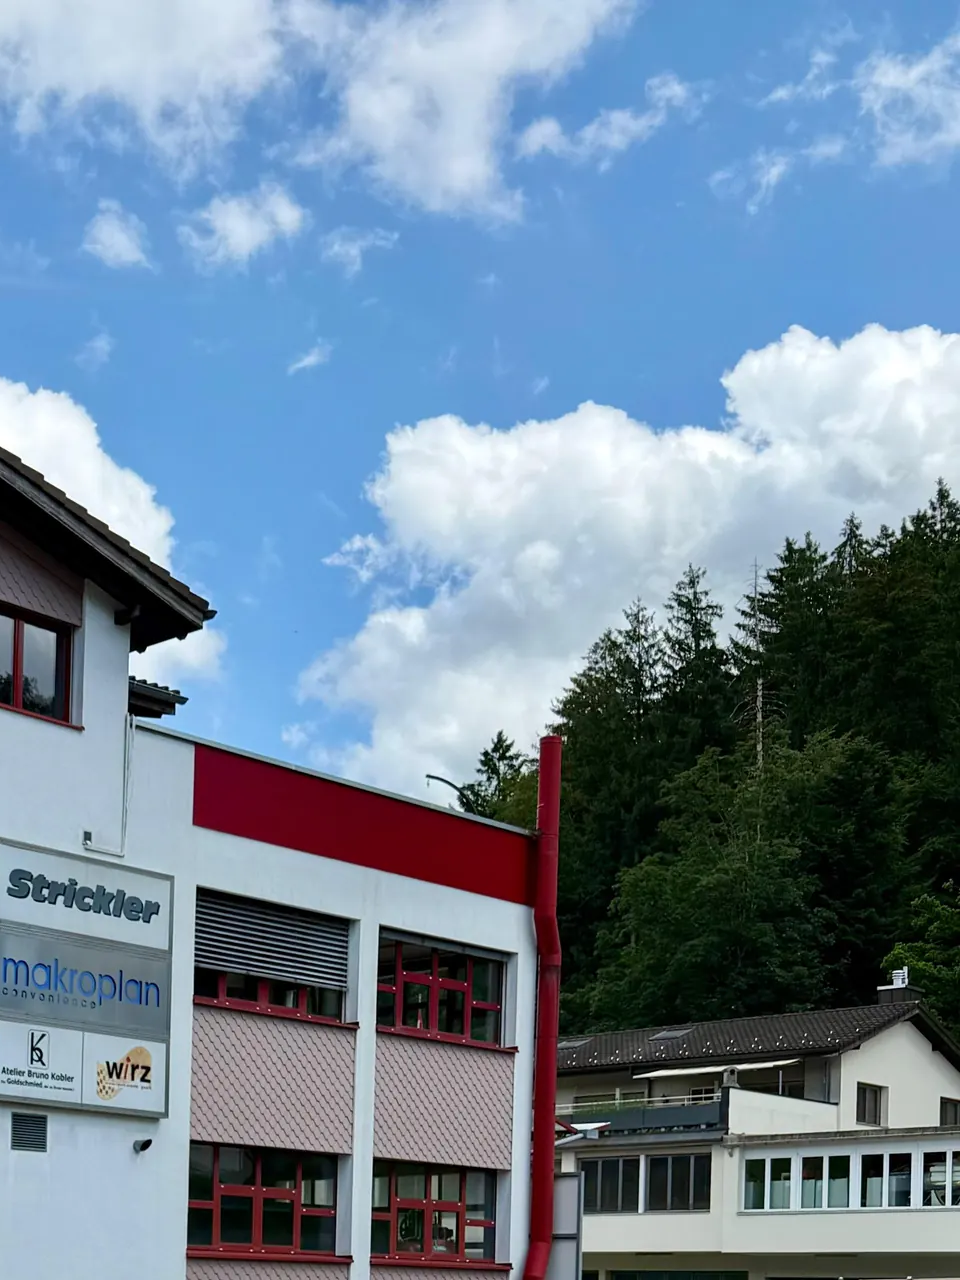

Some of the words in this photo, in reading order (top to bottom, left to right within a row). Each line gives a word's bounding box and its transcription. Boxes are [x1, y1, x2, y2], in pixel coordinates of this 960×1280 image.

[6, 868, 161, 924] Strickler
[2, 956, 160, 1008] makroplan
[1, 1066, 26, 1077] Atelier
[27, 1069, 49, 1080] Bruno
[51, 1072, 75, 1083] Kobler
[6, 1078, 43, 1089] Goldschmied
